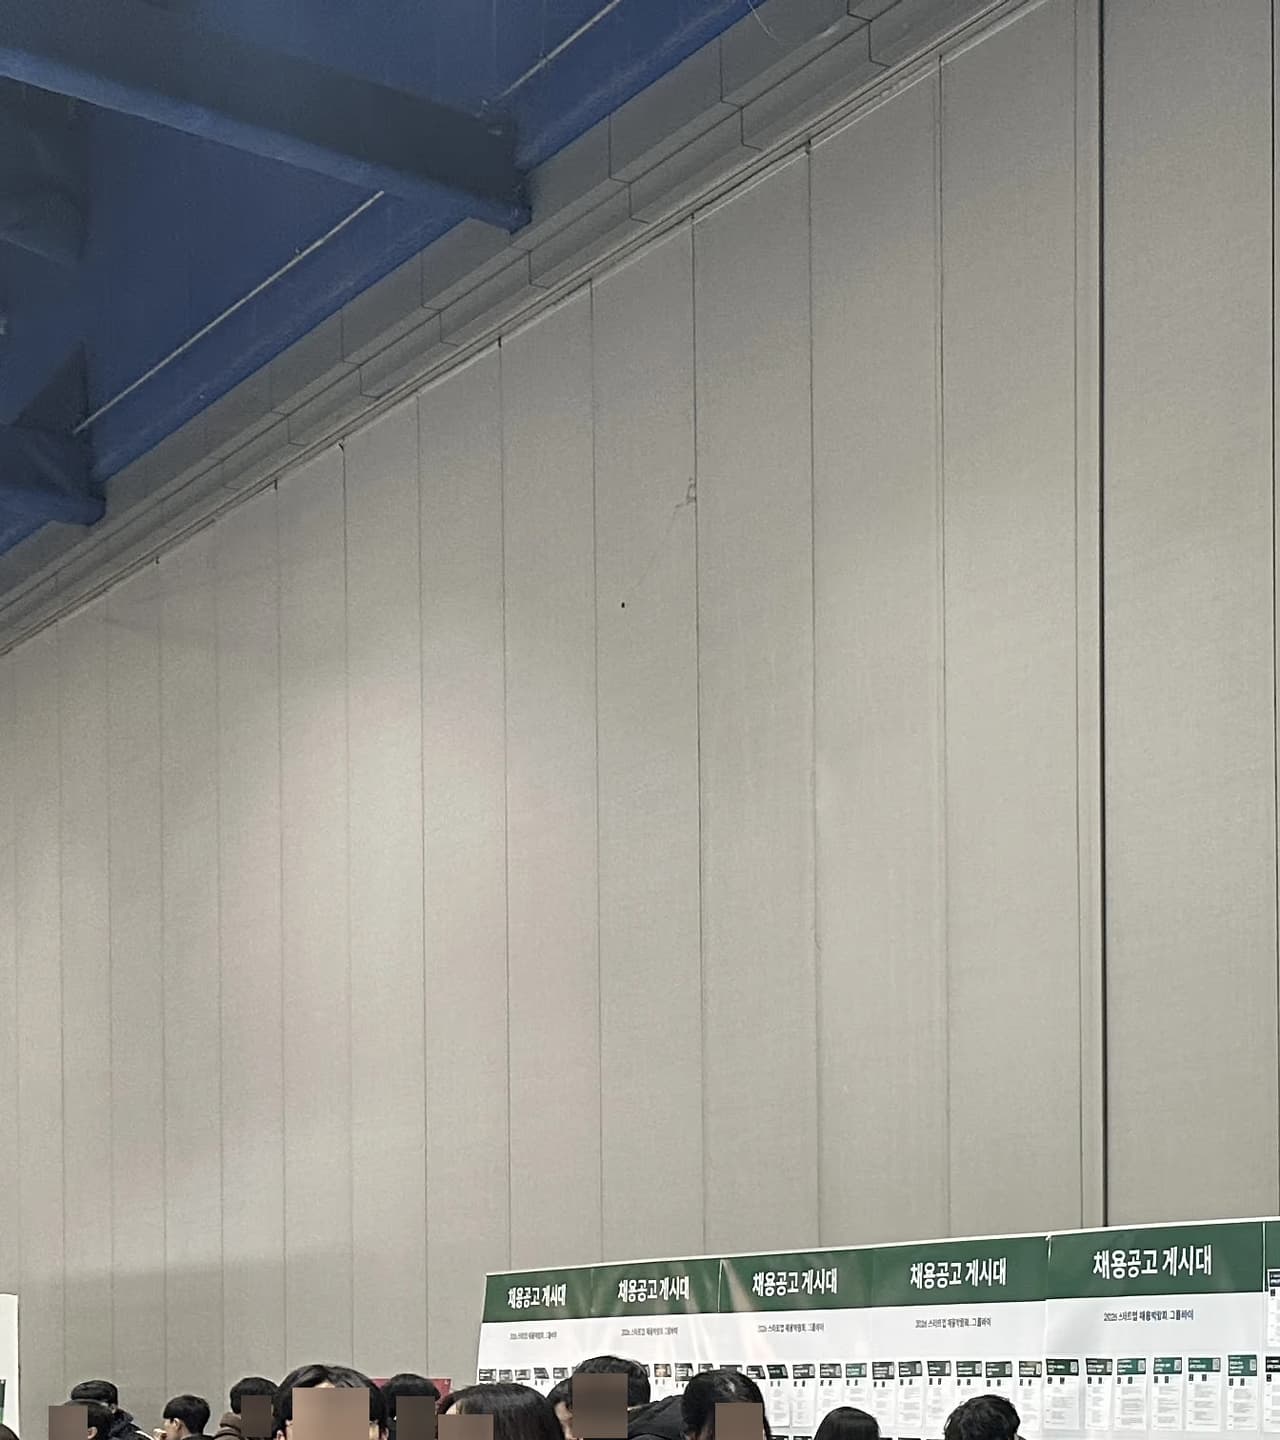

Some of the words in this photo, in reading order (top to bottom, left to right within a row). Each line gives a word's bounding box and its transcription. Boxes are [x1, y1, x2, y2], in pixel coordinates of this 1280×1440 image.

[910, 1262, 961, 1289] 채용공고
[965, 1258, 1006, 1286] 게시대
[1093, 1250, 1157, 1279] 채용공고
[1162, 1245, 1211, 1276] 게시대
[753, 1272, 799, 1296] 채용공고
[802, 1268, 837, 1294] 게시대
